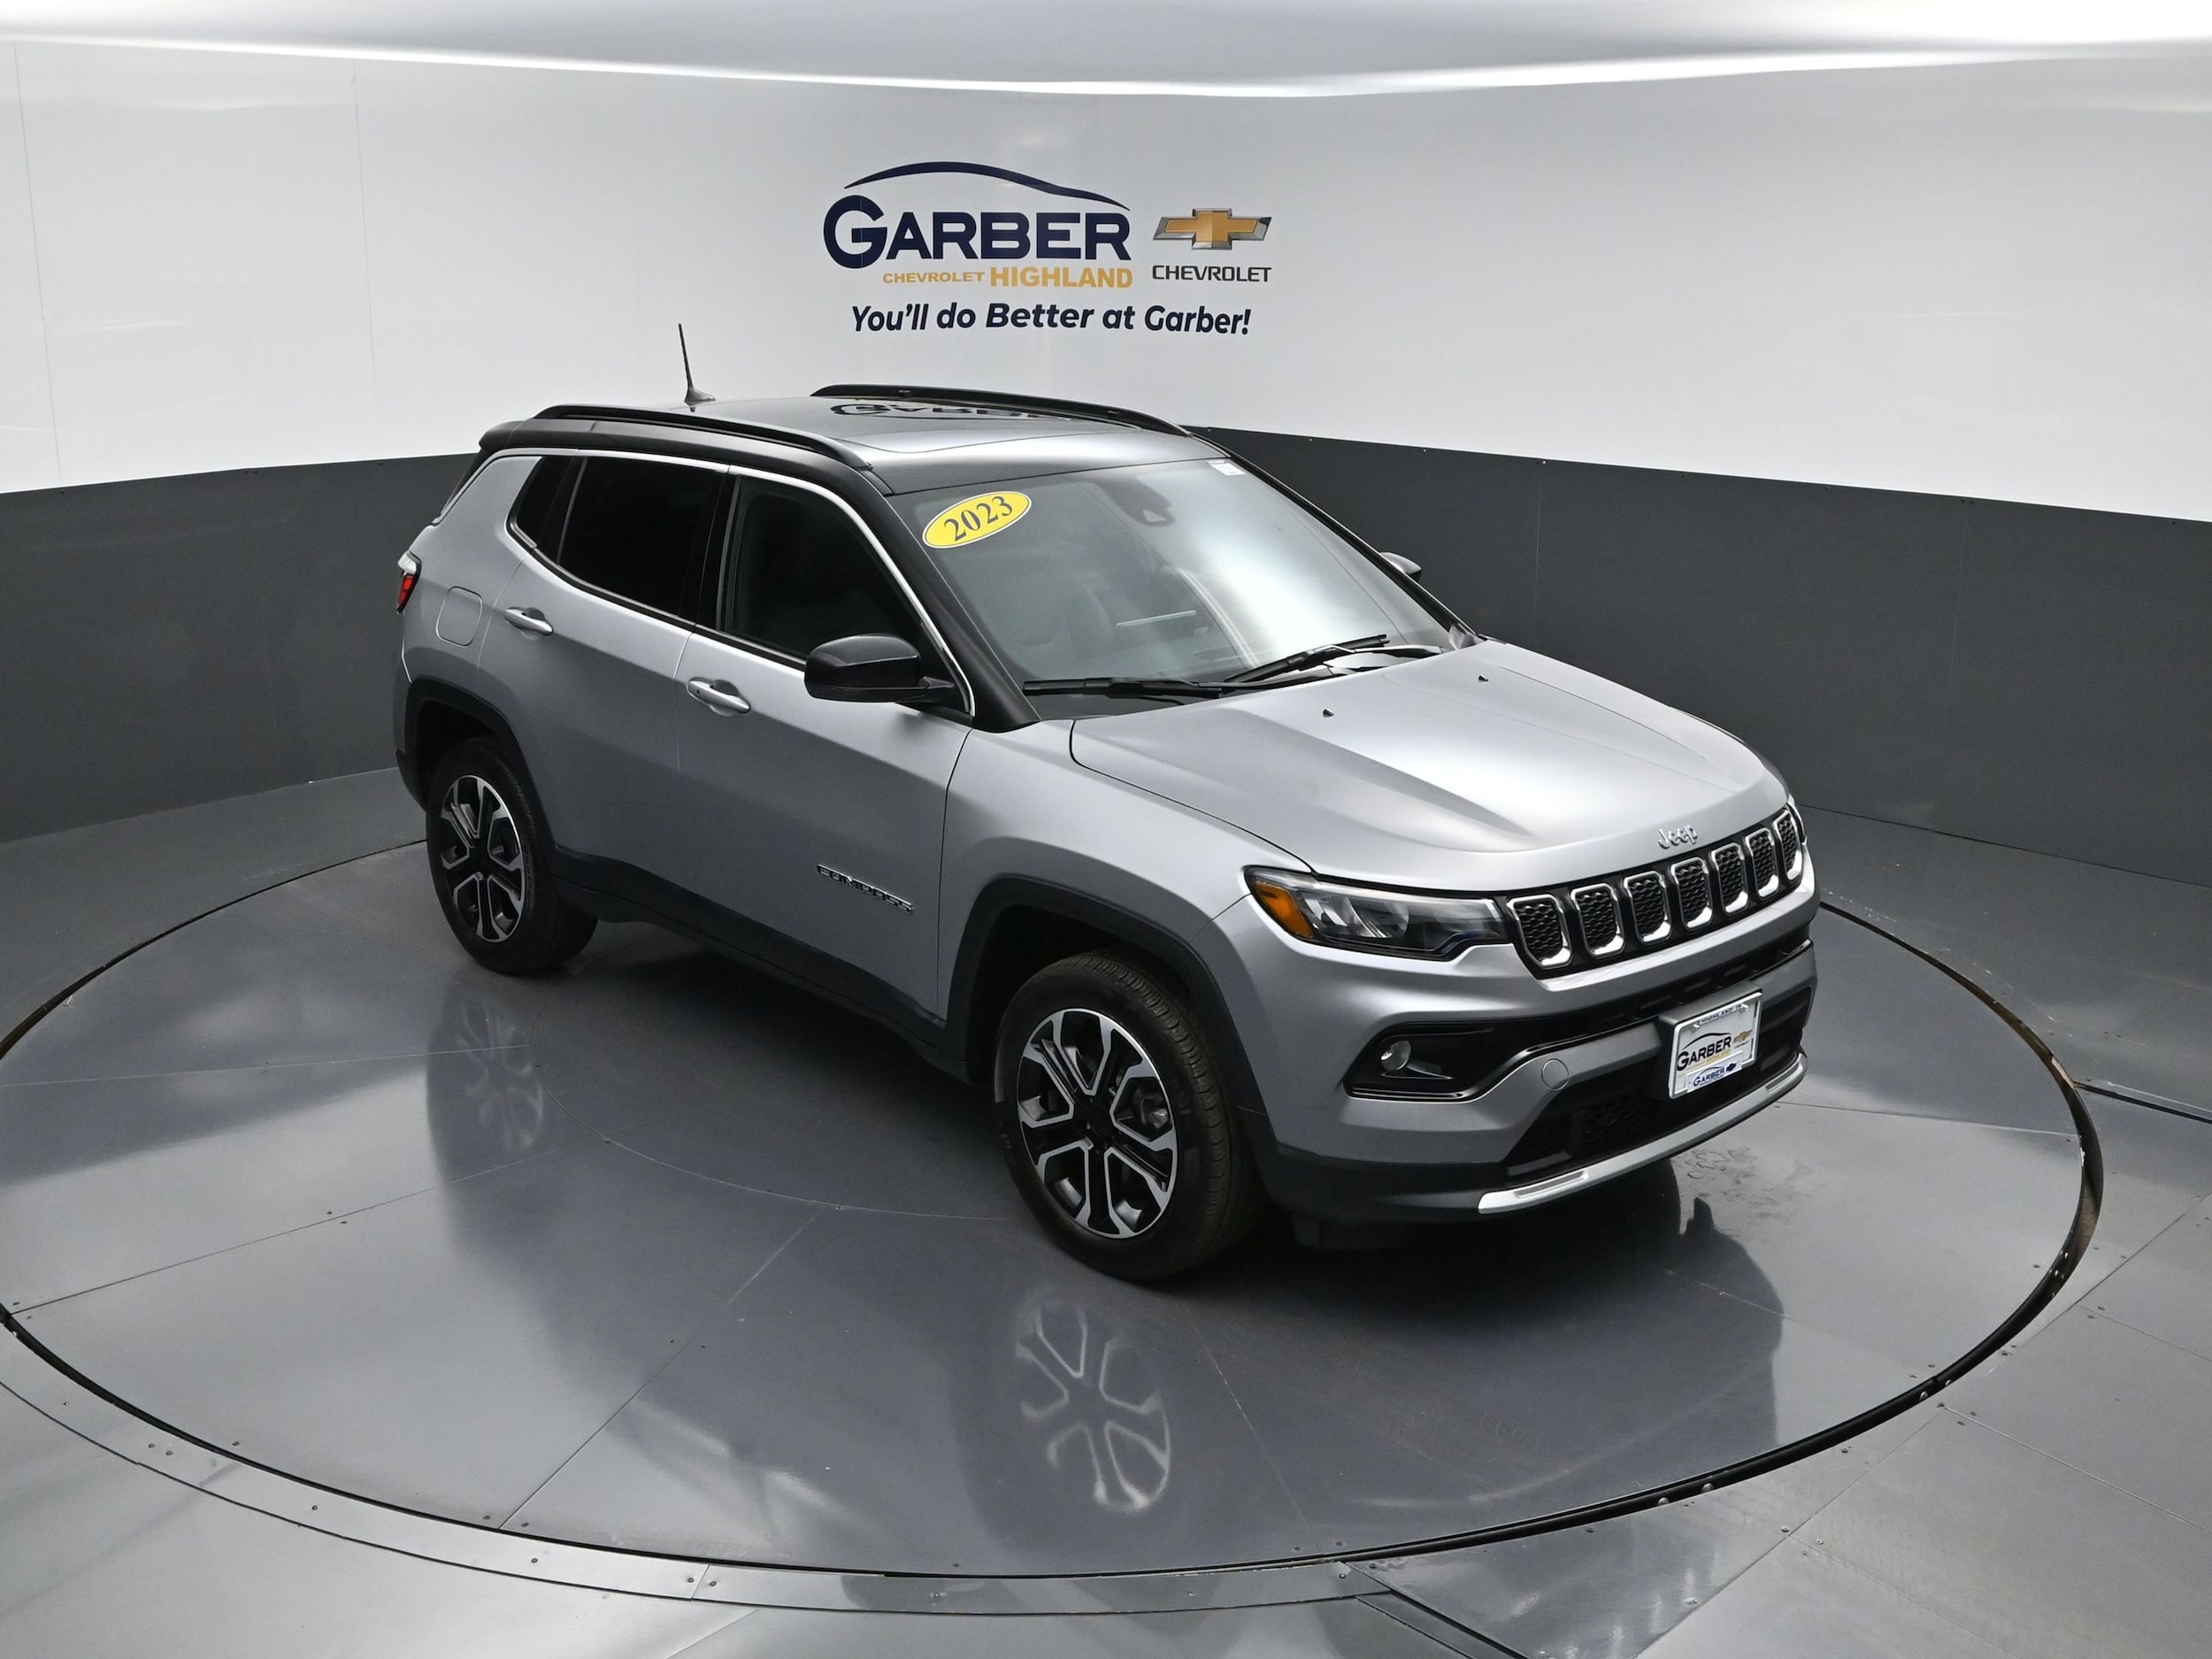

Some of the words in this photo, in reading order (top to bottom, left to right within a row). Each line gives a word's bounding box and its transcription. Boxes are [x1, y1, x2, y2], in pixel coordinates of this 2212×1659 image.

[823, 195, 1132, 269] GARBER
[882, 272, 985, 283] CHEVROLET
[990, 266, 1133, 288] HIGHLAND
[1152, 265, 1271, 282] CHEVROLET
[936, 302, 977, 329] do
[986, 303, 1094, 328] Better
[1102, 305, 1135, 330] at
[1145, 304, 1251, 334] Garber!
[944, 495, 1012, 541] 2023
[1657, 825, 1698, 849] Jeep
[1677, 1036, 1732, 1071] GARBER
[1693, 1067, 1725, 1087] GARBER
